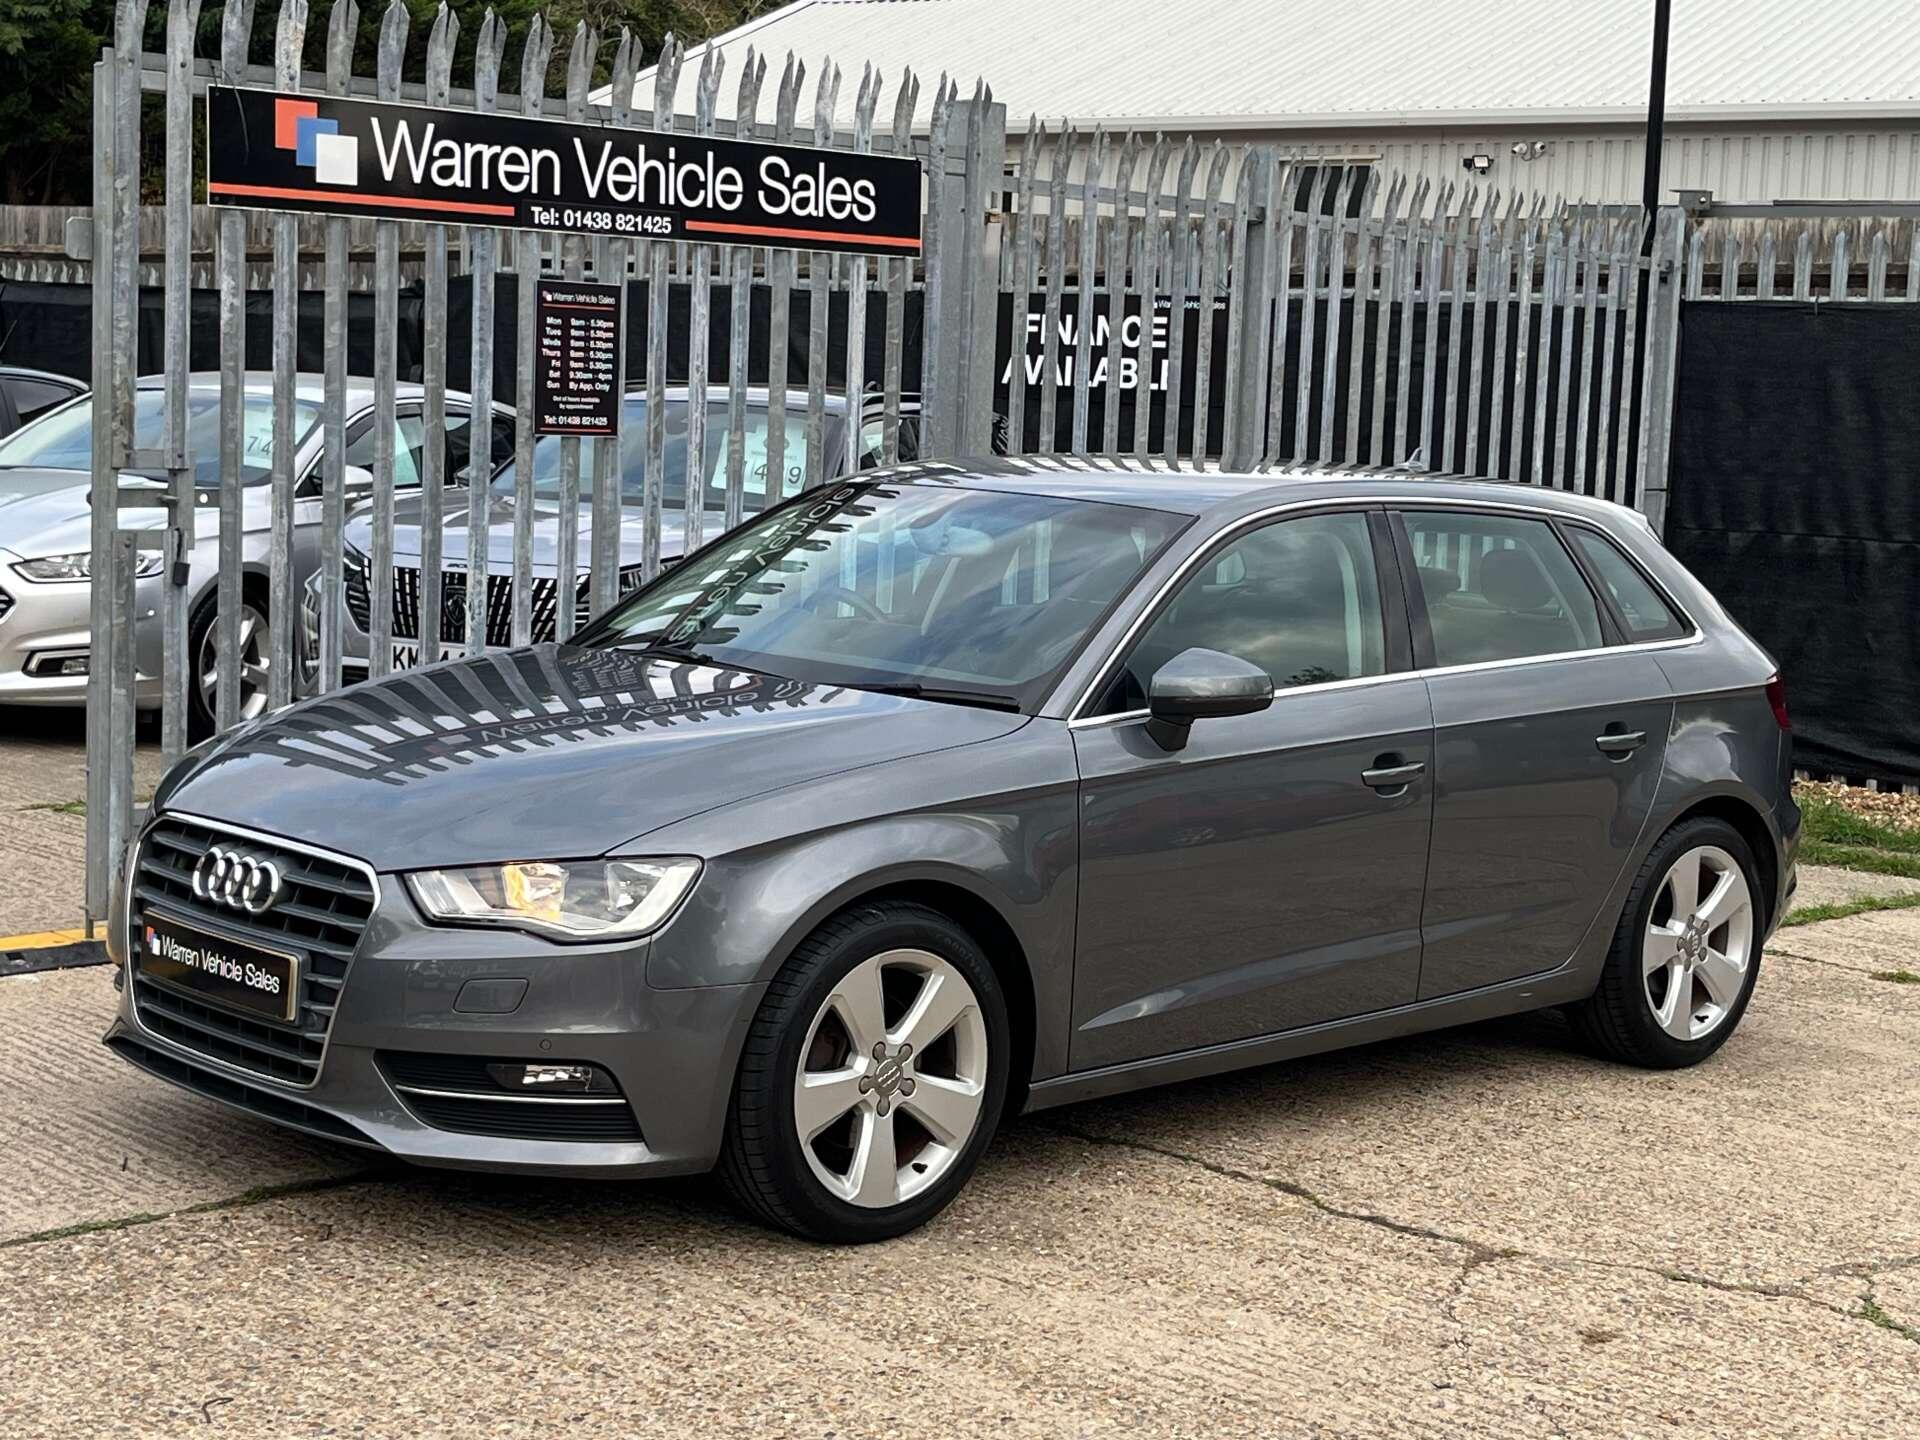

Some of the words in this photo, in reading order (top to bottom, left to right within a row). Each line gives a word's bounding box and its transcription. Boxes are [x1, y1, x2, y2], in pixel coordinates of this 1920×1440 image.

[370, 116, 561, 196] Warren
[573, 137, 743, 212] Vehicle
[758, 155, 876, 222] Sales
[530, 206, 560, 226] Tel:
[563, 209, 612, 230] 01438
[615, 212, 672, 234] 821425
[546, 316, 562, 325] Mon
[545, 327, 562, 336] Tues
[551, 360, 561, 368] Fri
[549, 370, 561, 379] Sat
[546, 380, 561, 389] Sun
[569, 382, 578, 391] By
[162, 934, 199, 968] Warren
[201, 948, 243, 982] Vehicle
[245, 963, 280, 994] Sales
